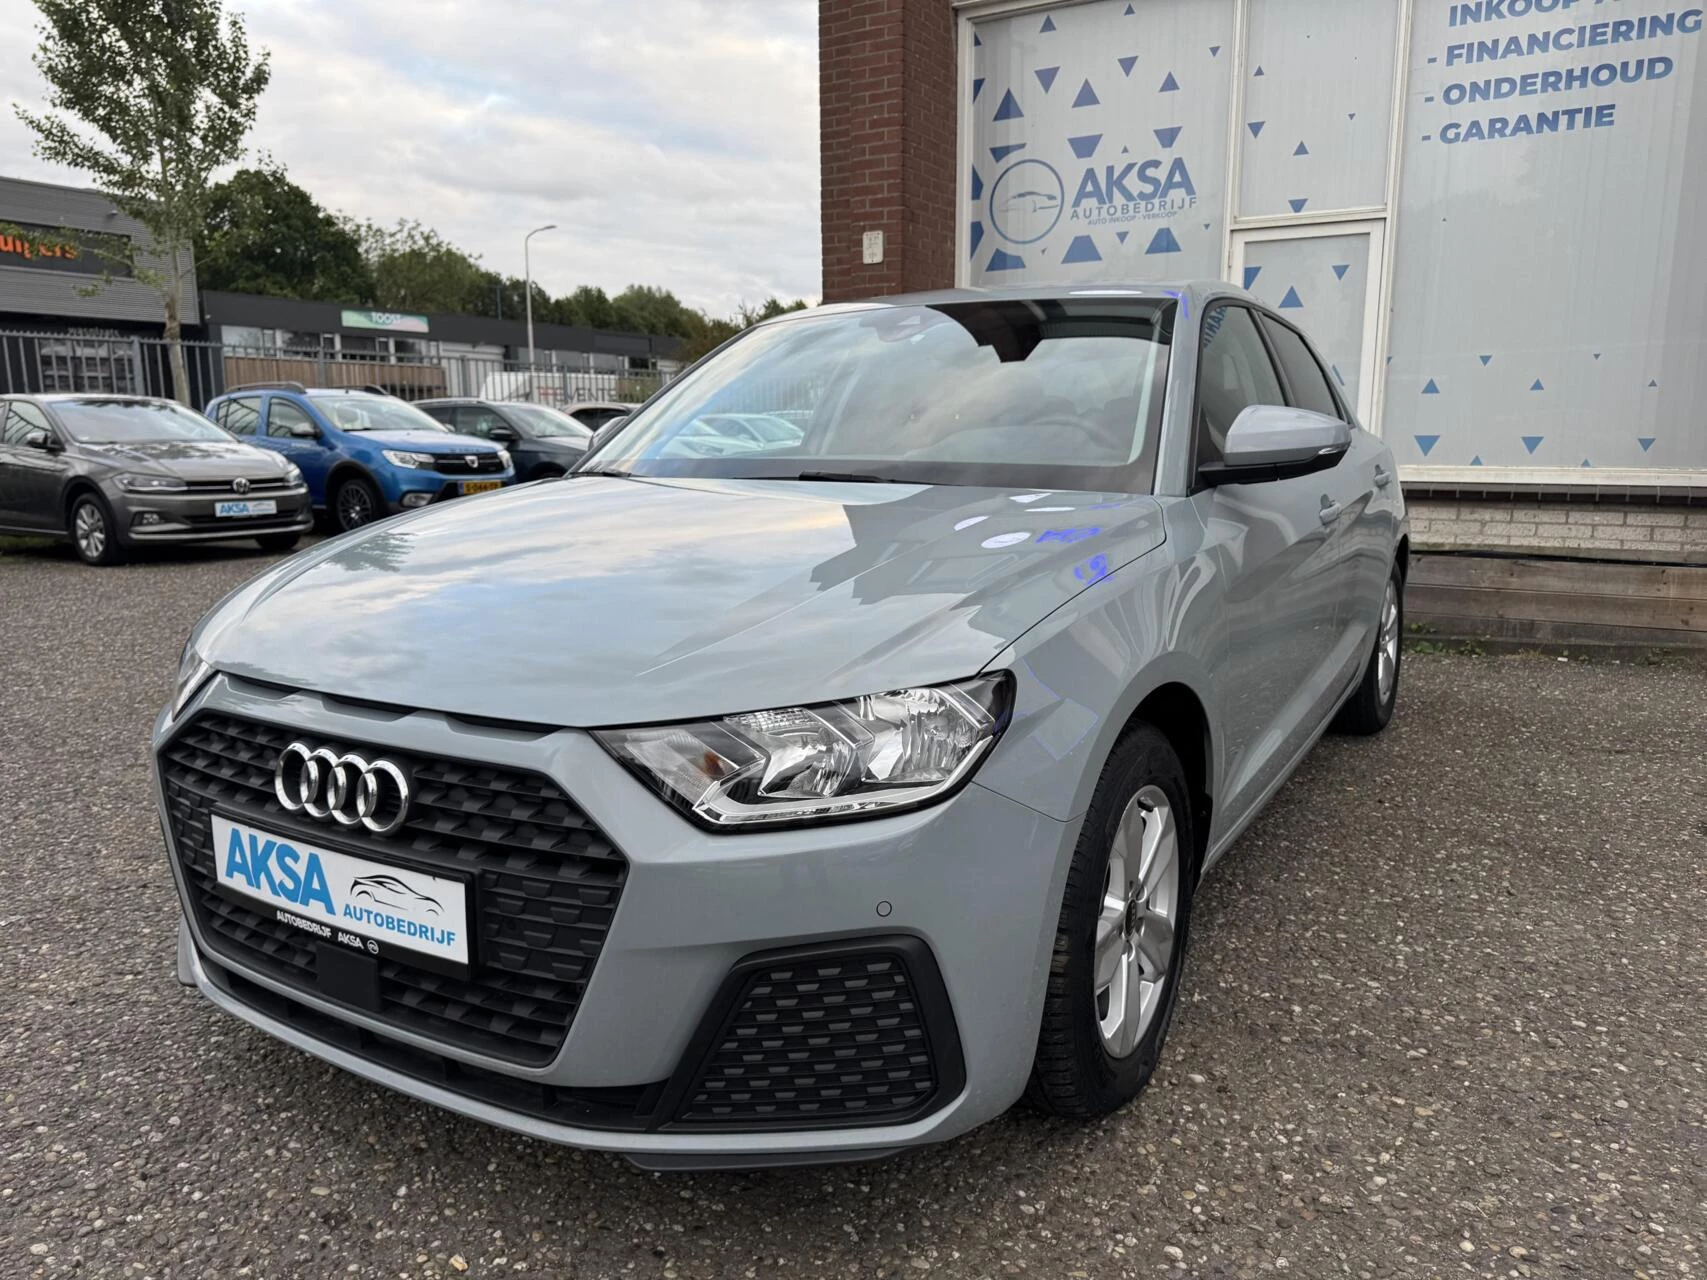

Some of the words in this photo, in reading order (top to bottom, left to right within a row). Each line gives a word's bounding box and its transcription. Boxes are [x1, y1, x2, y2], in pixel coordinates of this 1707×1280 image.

[1446, 9, 1703, 67] FINANCIERING
[1442, 56, 1673, 105] ONDERHOUD
[1439, 103, 1616, 144] GARANTIE
[1071, 156, 1197, 209] AKSA
[1070, 197, 1198, 221] AUTOBEDRIJF
[1087, 217, 1108, 226] AUTO
[220, 503, 249, 514] AKSA
[225, 827, 336, 916] AKSA
[276, 910, 332, 938] AUTOBEDRIJF
[337, 931, 365, 950] AKSA
[343, 903, 456, 947] AUTOBEDRIJF
